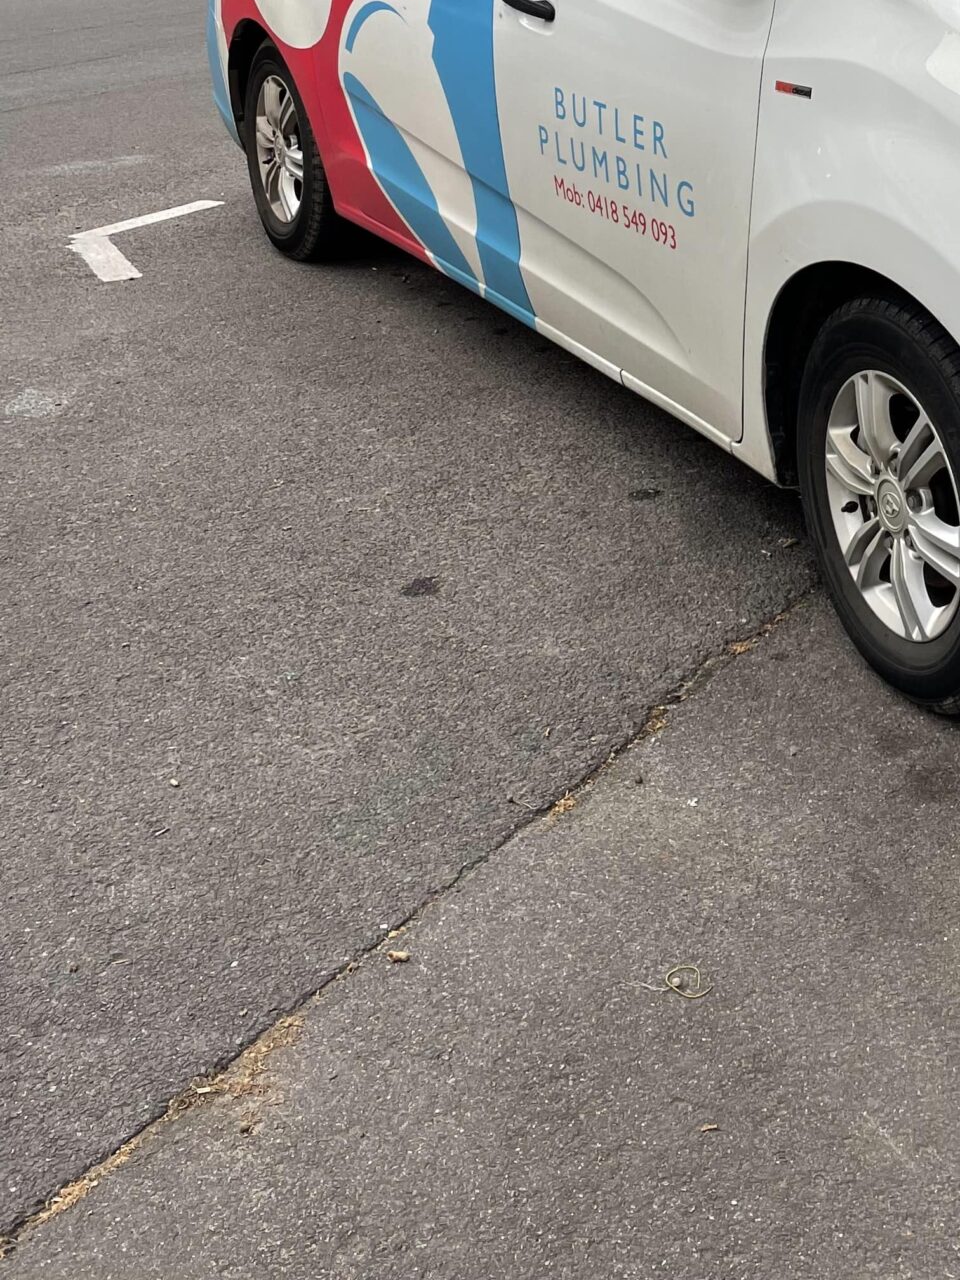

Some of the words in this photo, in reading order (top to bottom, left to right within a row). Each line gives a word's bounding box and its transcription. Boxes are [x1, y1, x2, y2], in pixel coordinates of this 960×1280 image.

[554, 87, 668, 159] BUTLER
[538, 124, 695, 217] PLUMBING
[553, 174, 585, 208] Mob:
[587, 190, 619, 224] 0418
[622, 205, 647, 235] 549
[651, 218, 677, 250] 093
